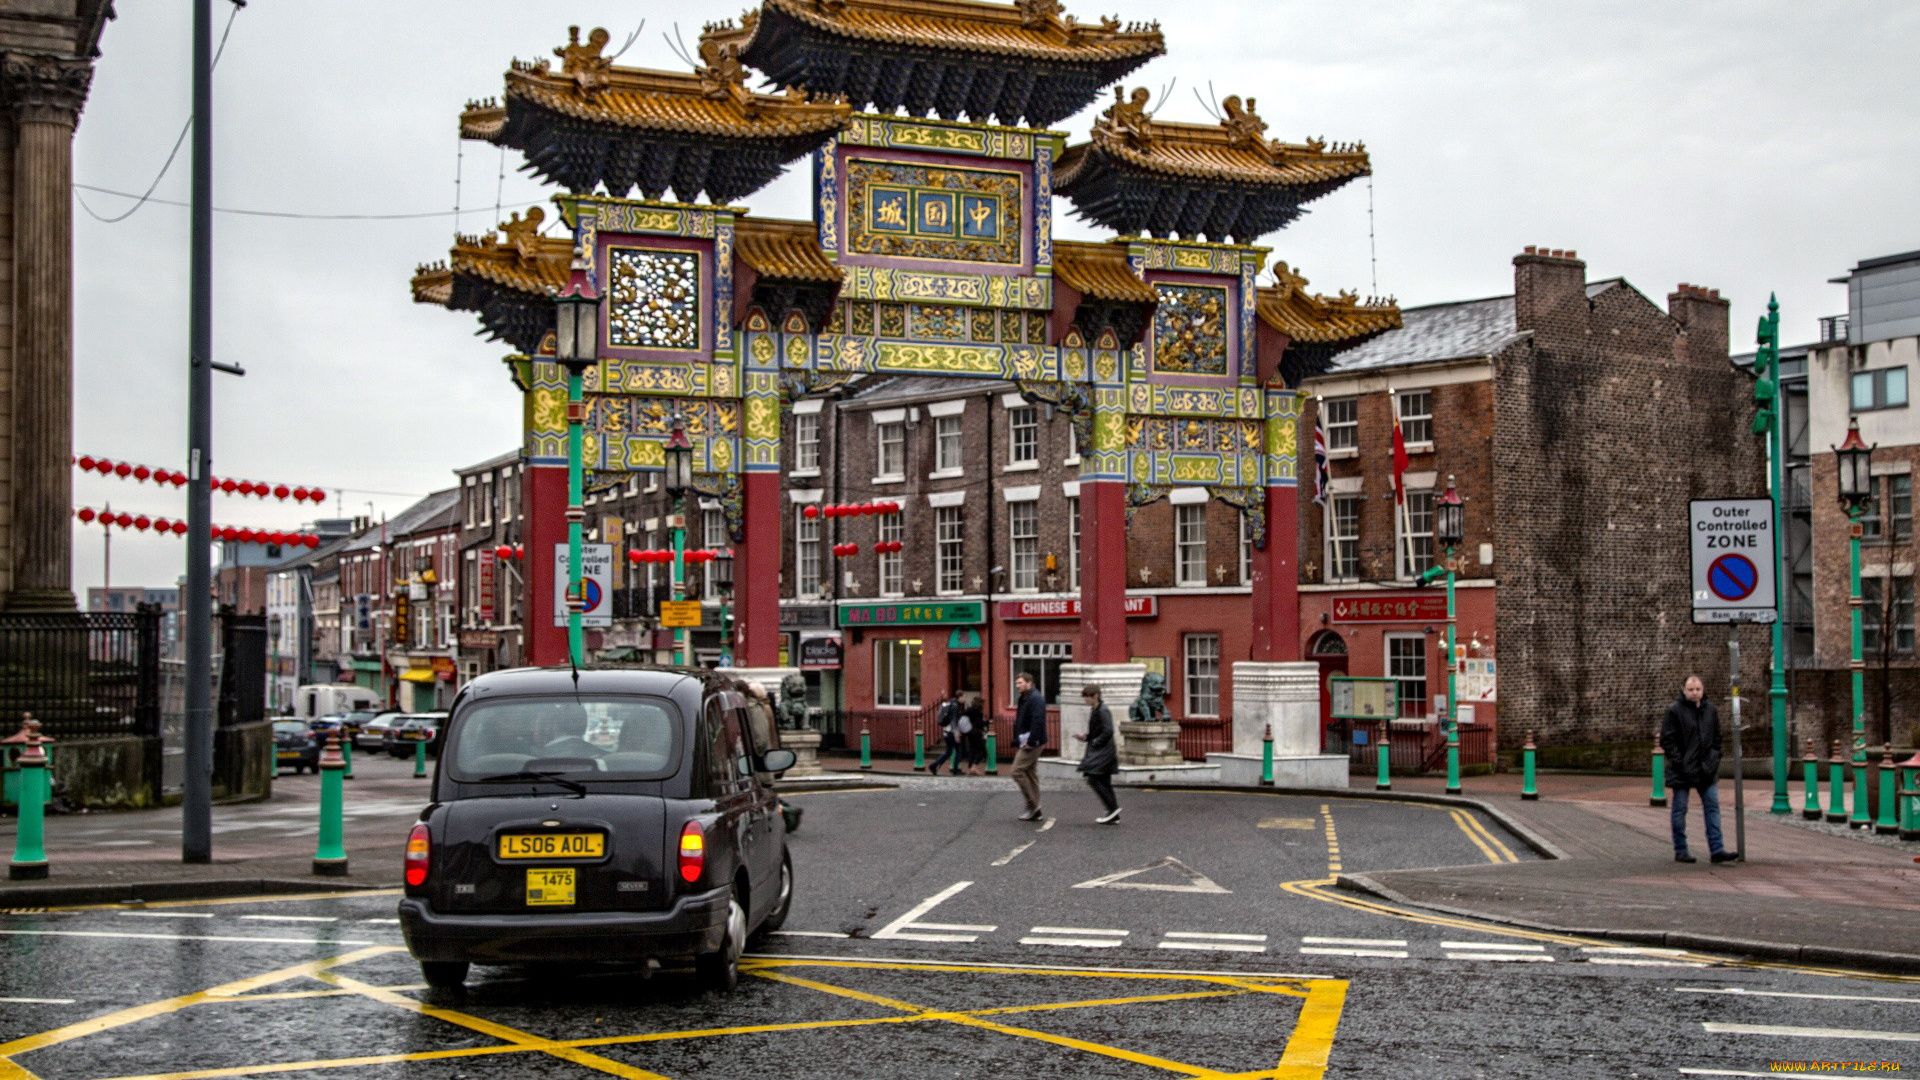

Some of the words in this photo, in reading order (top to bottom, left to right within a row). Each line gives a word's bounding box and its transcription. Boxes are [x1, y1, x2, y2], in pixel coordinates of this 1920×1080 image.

[1712, 507, 1750, 517] Outer
[1697, 521, 1767, 531] Controlled
[1707, 535, 1757, 548] ZONE
[1021, 601, 1068, 614] CHINESE
[508, 837, 555, 854] LS06
[561, 836, 595, 853] AOL
[541, 874, 573, 886] 1475
